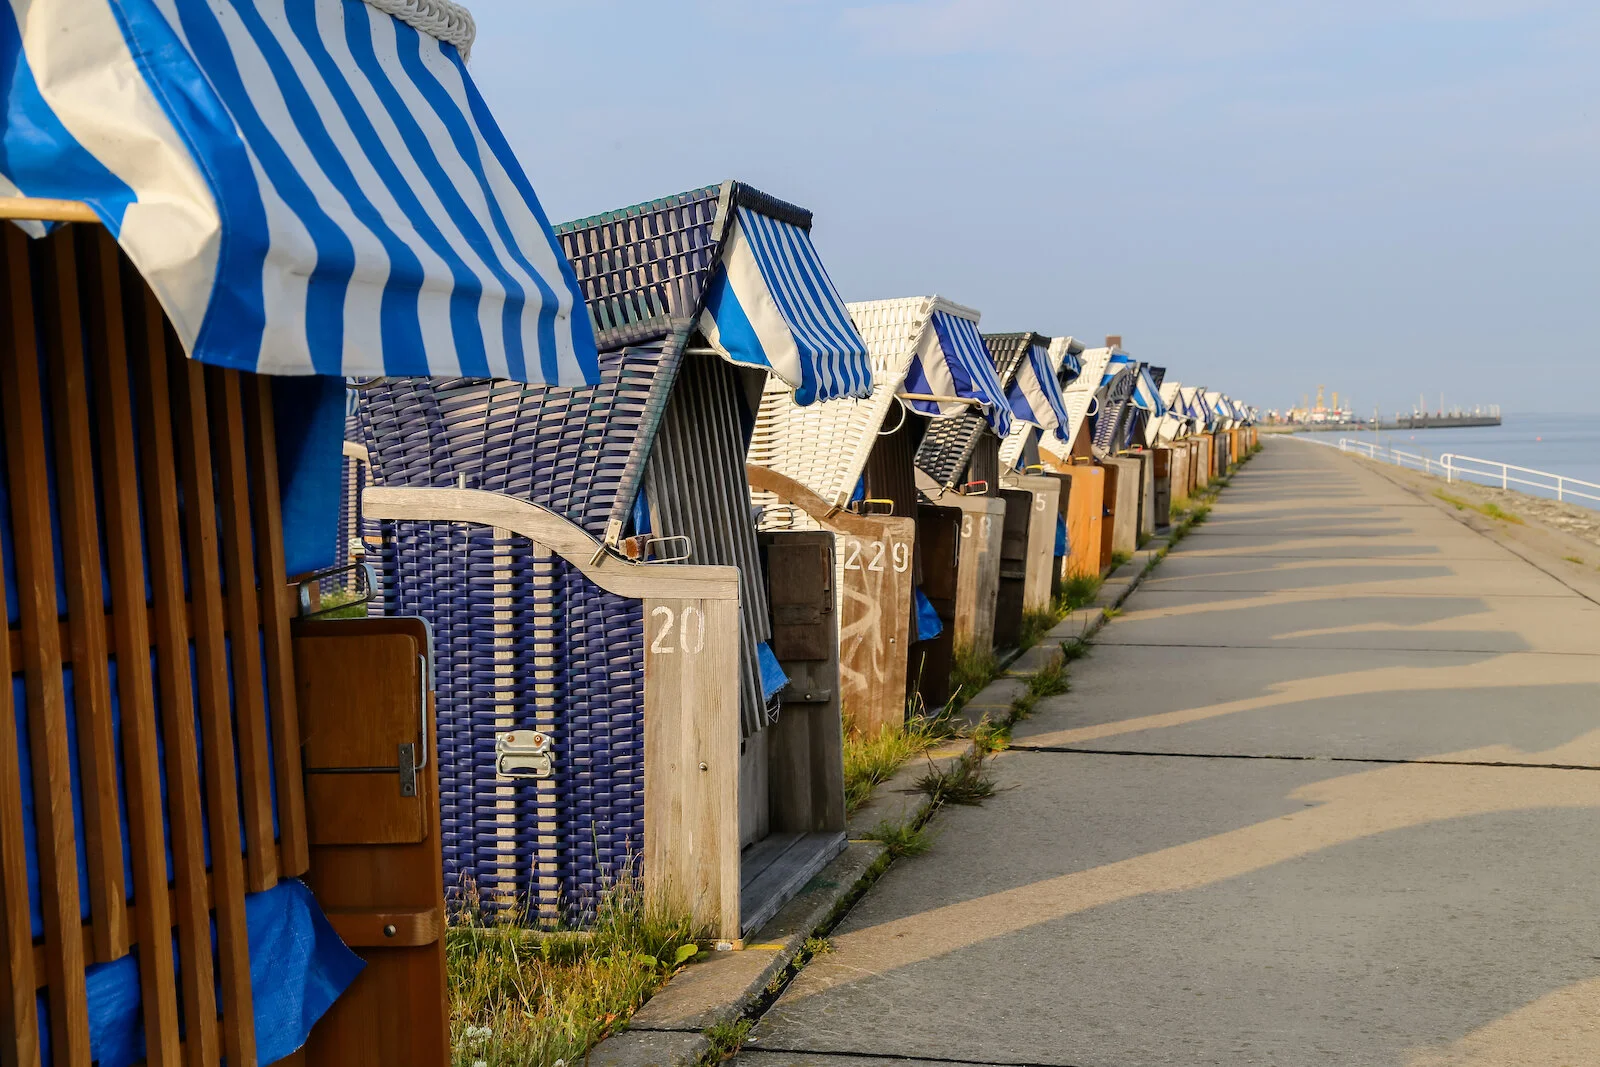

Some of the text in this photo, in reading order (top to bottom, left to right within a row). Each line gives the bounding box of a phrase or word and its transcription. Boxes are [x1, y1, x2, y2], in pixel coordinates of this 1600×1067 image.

[1035, 493, 1047, 512] 5
[844, 540, 909, 573] 229
[651, 605, 705, 654] 20
